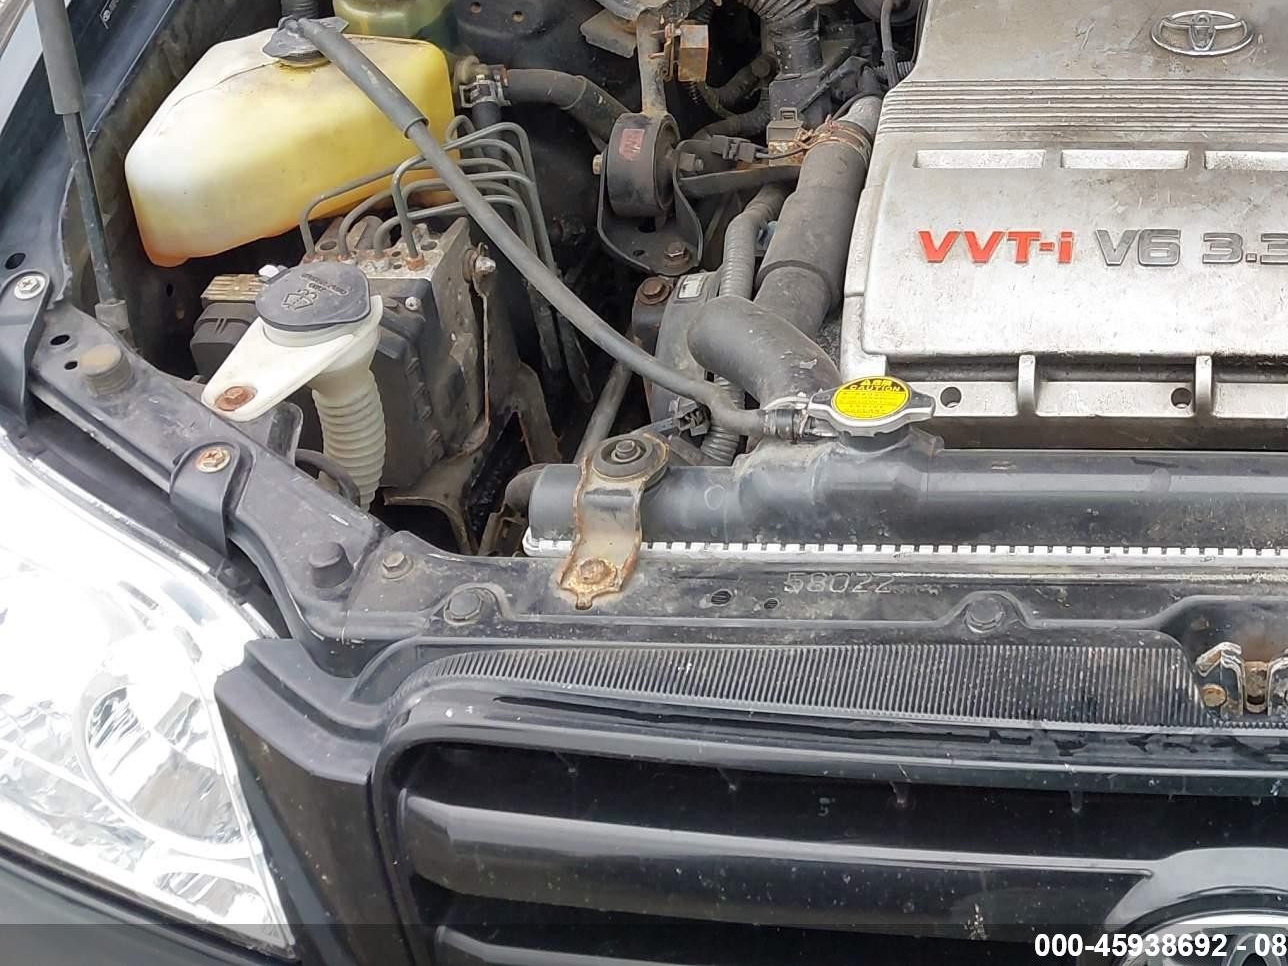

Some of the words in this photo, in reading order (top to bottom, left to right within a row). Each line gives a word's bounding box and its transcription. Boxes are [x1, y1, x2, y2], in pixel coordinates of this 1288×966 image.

[918, 230, 1074, 264] VVT-i
[1095, 228, 1182, 266] V6
[849, 384, 901, 392] CAUTION
[783, 571, 895, 594] 58022
